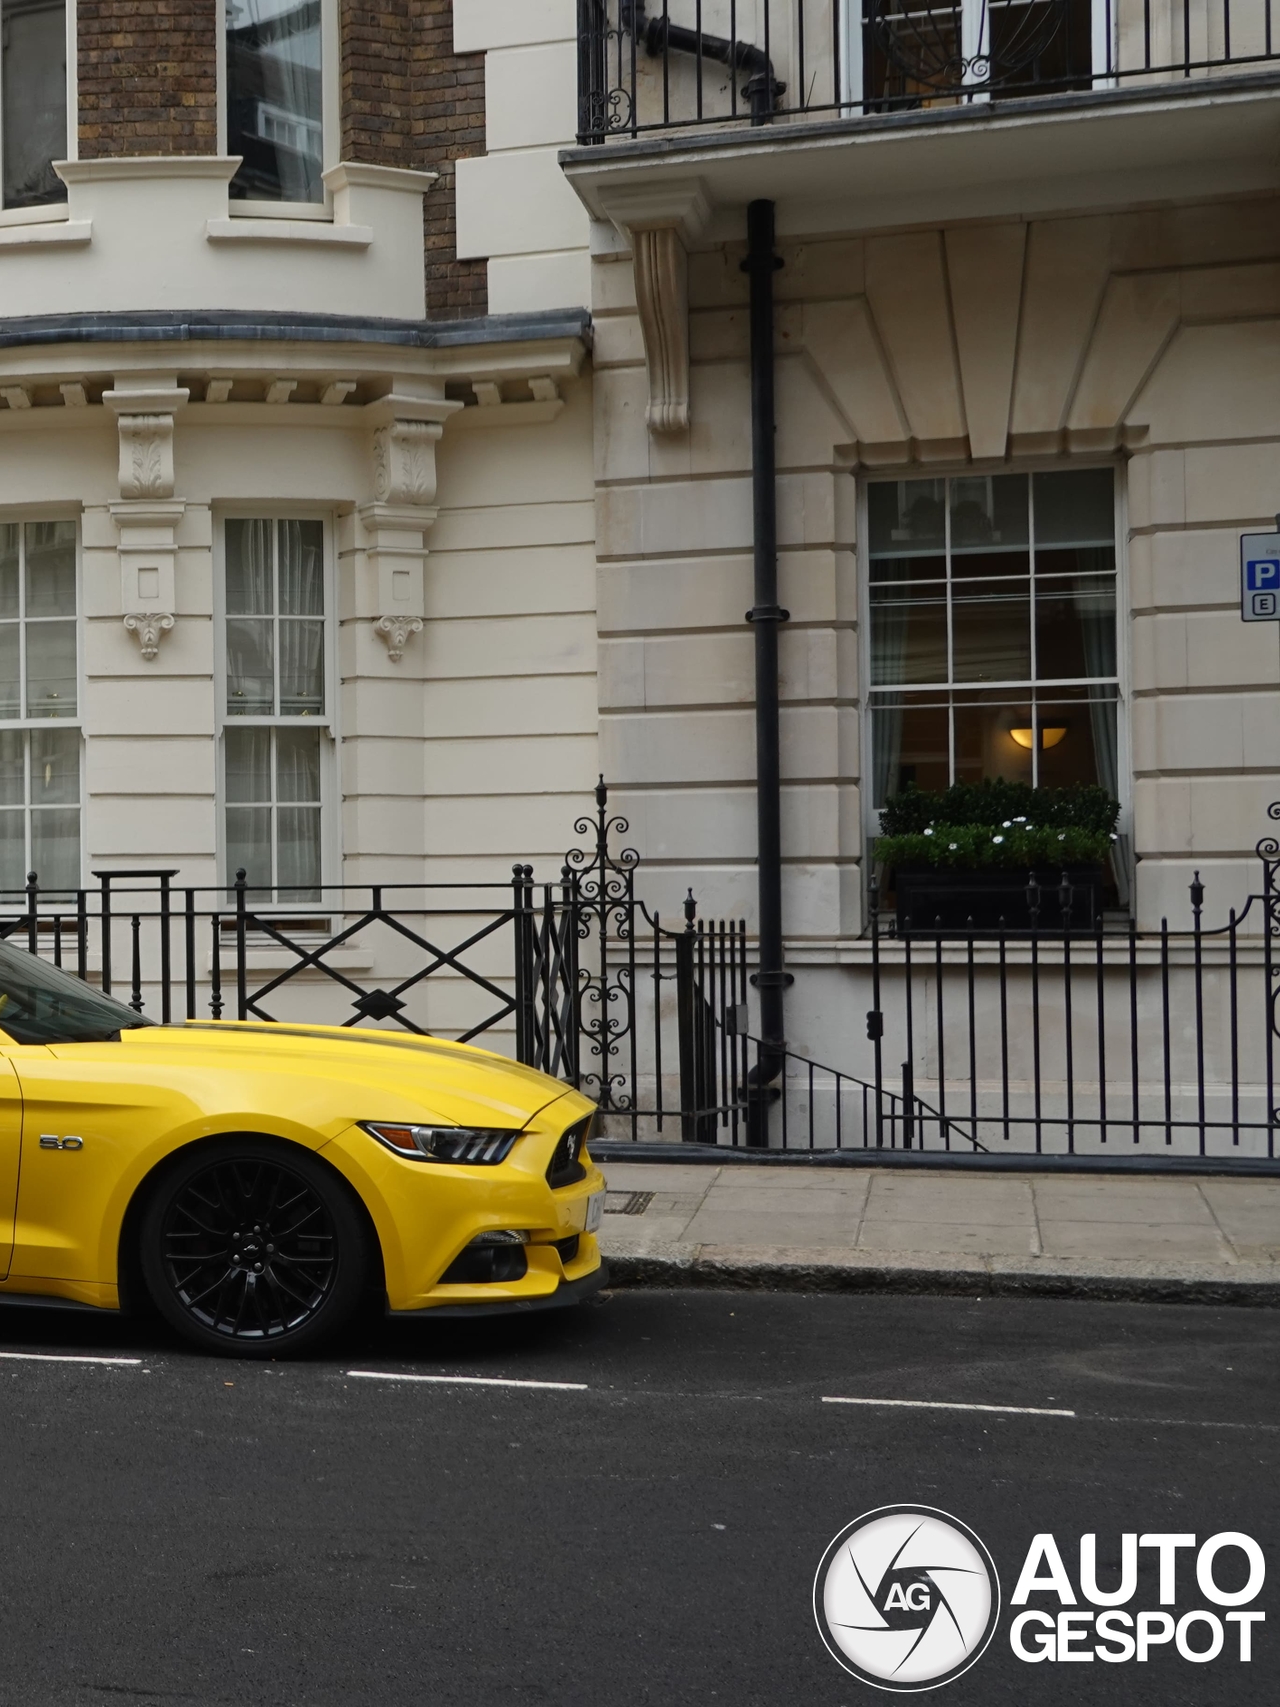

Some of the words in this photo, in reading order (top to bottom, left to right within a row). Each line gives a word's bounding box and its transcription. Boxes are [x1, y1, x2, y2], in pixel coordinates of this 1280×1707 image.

[1255, 563, 1276, 588] P
[1260, 599, 1269, 610] E
[39, 1134, 84, 1150] 5.0
